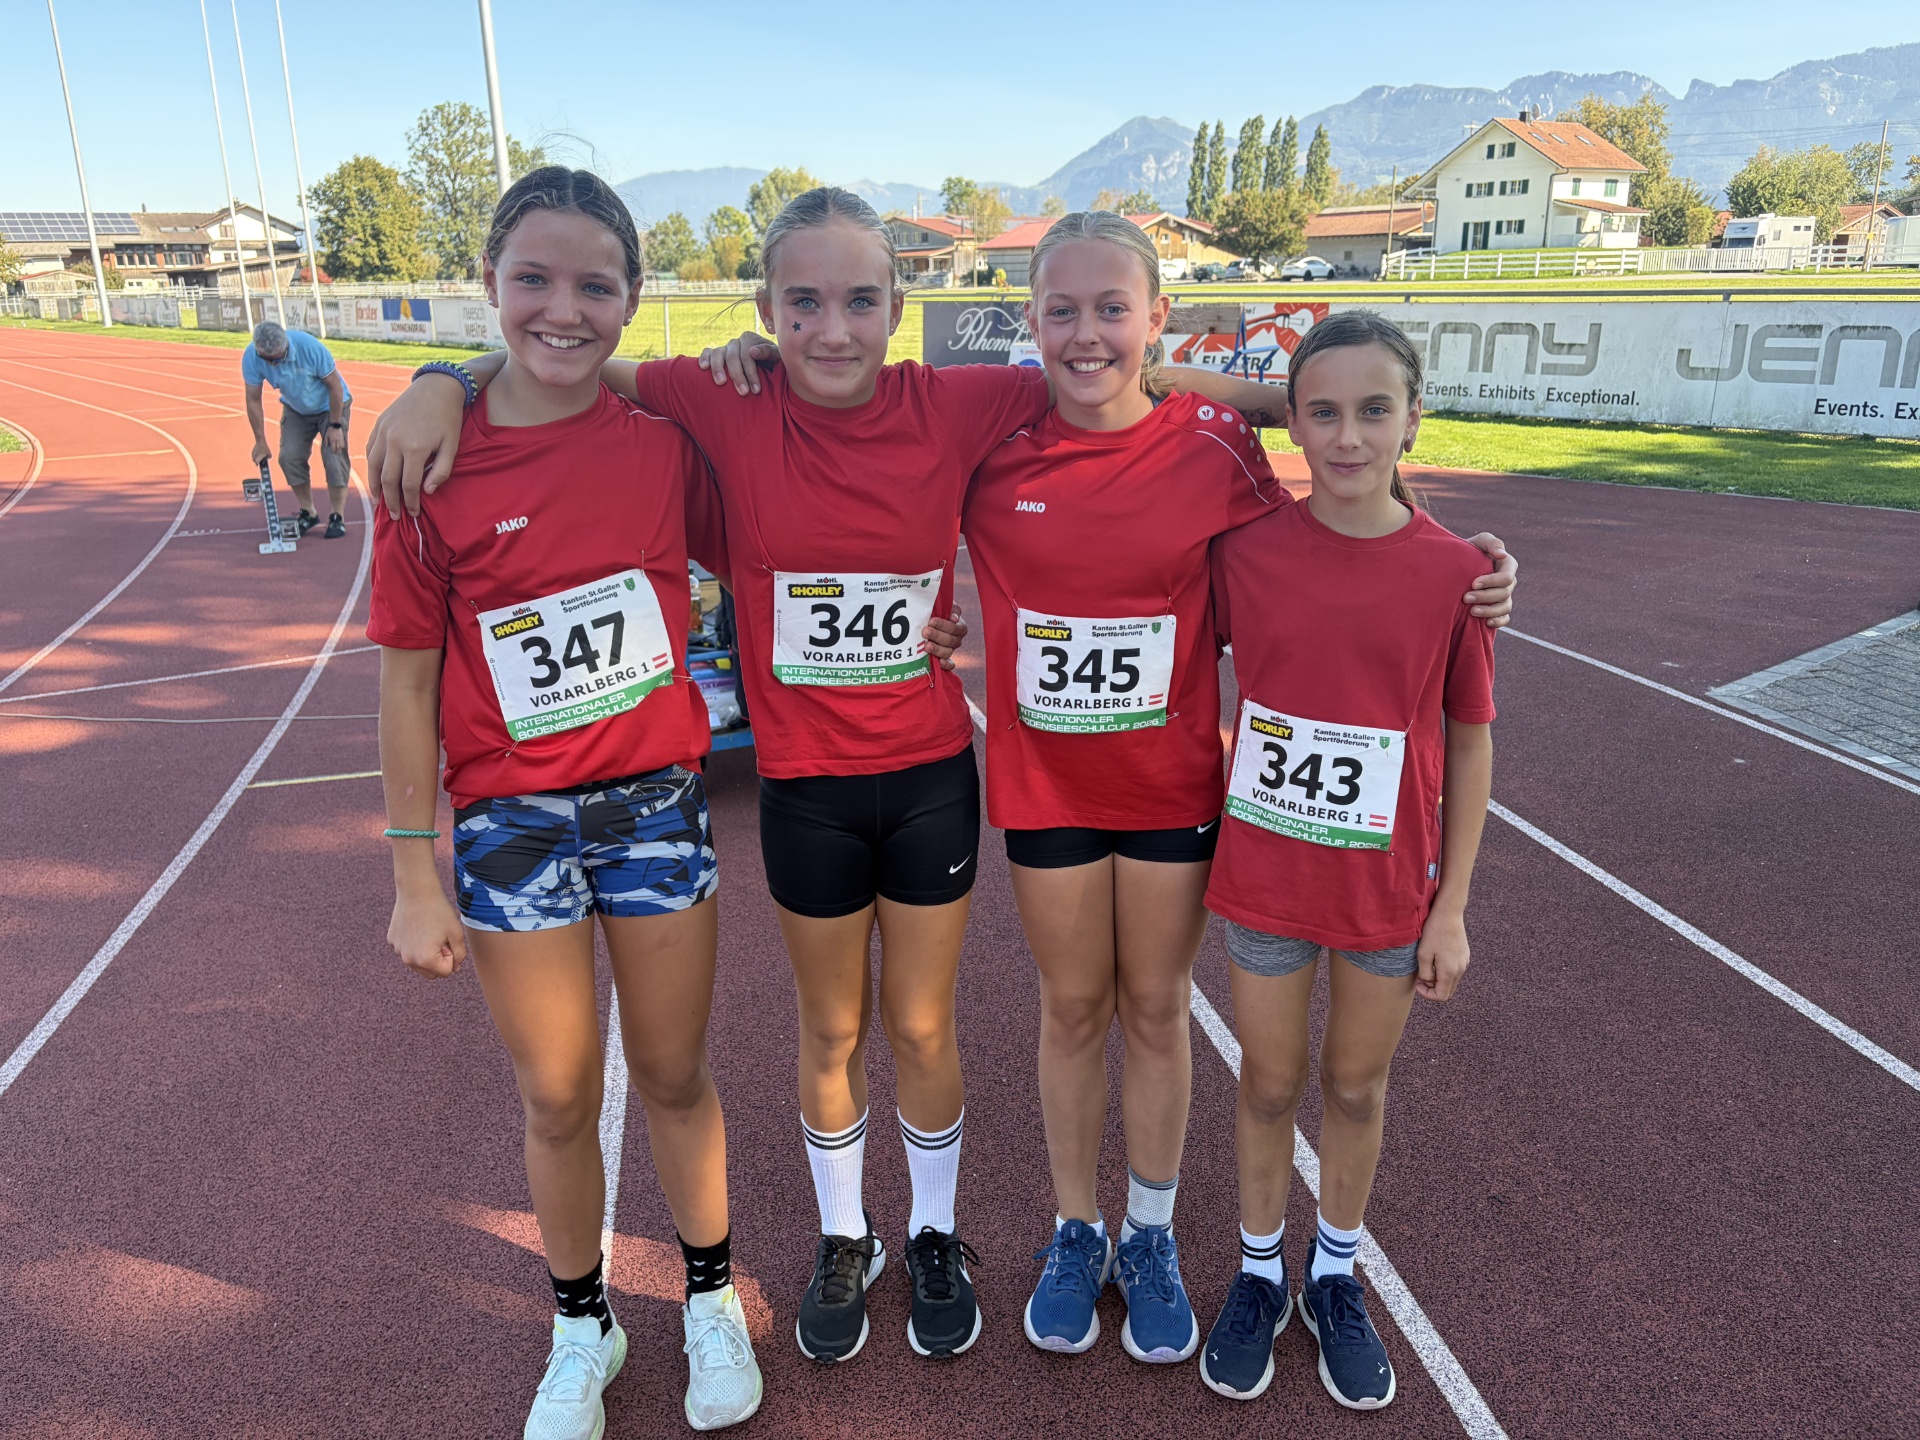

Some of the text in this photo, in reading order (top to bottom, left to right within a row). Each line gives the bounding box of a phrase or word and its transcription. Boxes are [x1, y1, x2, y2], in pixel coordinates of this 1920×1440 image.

[1676, 324, 1920, 389] JEN
[1425, 382, 1640, 406] Events. Exhibits Exceptional.
[1814, 398, 1920, 420] Events. Ex
[1015, 501, 1046, 513] JAKO
[495, 516, 529, 535] JAKO
[560, 594, 587, 606] Kanton
[791, 586, 842, 596] SHORLEY
[563, 591, 618, 613] Sportförderung
[495, 614, 539, 638] SHORLEY
[809, 599, 910, 648] 346
[1027, 626, 1070, 639] SHORLEY
[1092, 630, 1142, 638] Sportförderung
[520, 610, 625, 689] 347
[803, 647, 913, 663] VORARLBERG 1
[781, 667, 886, 676] INTERNATIONALER
[1038, 646, 1140, 693] 345
[529, 667, 637, 708] VORARLBERG
[641, 662, 650, 674] 1
[782, 675, 901, 685] BODENSEESCHULCUP
[515, 692, 626, 730] INTERNATIONALER
[1034, 694, 1144, 709] VORARLBERG 1
[1020, 706, 1114, 723] INTERNATIONALER
[1251, 719, 1291, 738] SHORLEY
[1314, 728, 1341, 737] Kanton
[1313, 735, 1369, 748] Sportförderung
[1259, 741, 1363, 805] 343
[1252, 788, 1362, 824] VORARLBERG 1
[1229, 808, 1345, 846] BODENSEESCHULCUP
[1232, 799, 1328, 835] INTERNATIONALER
